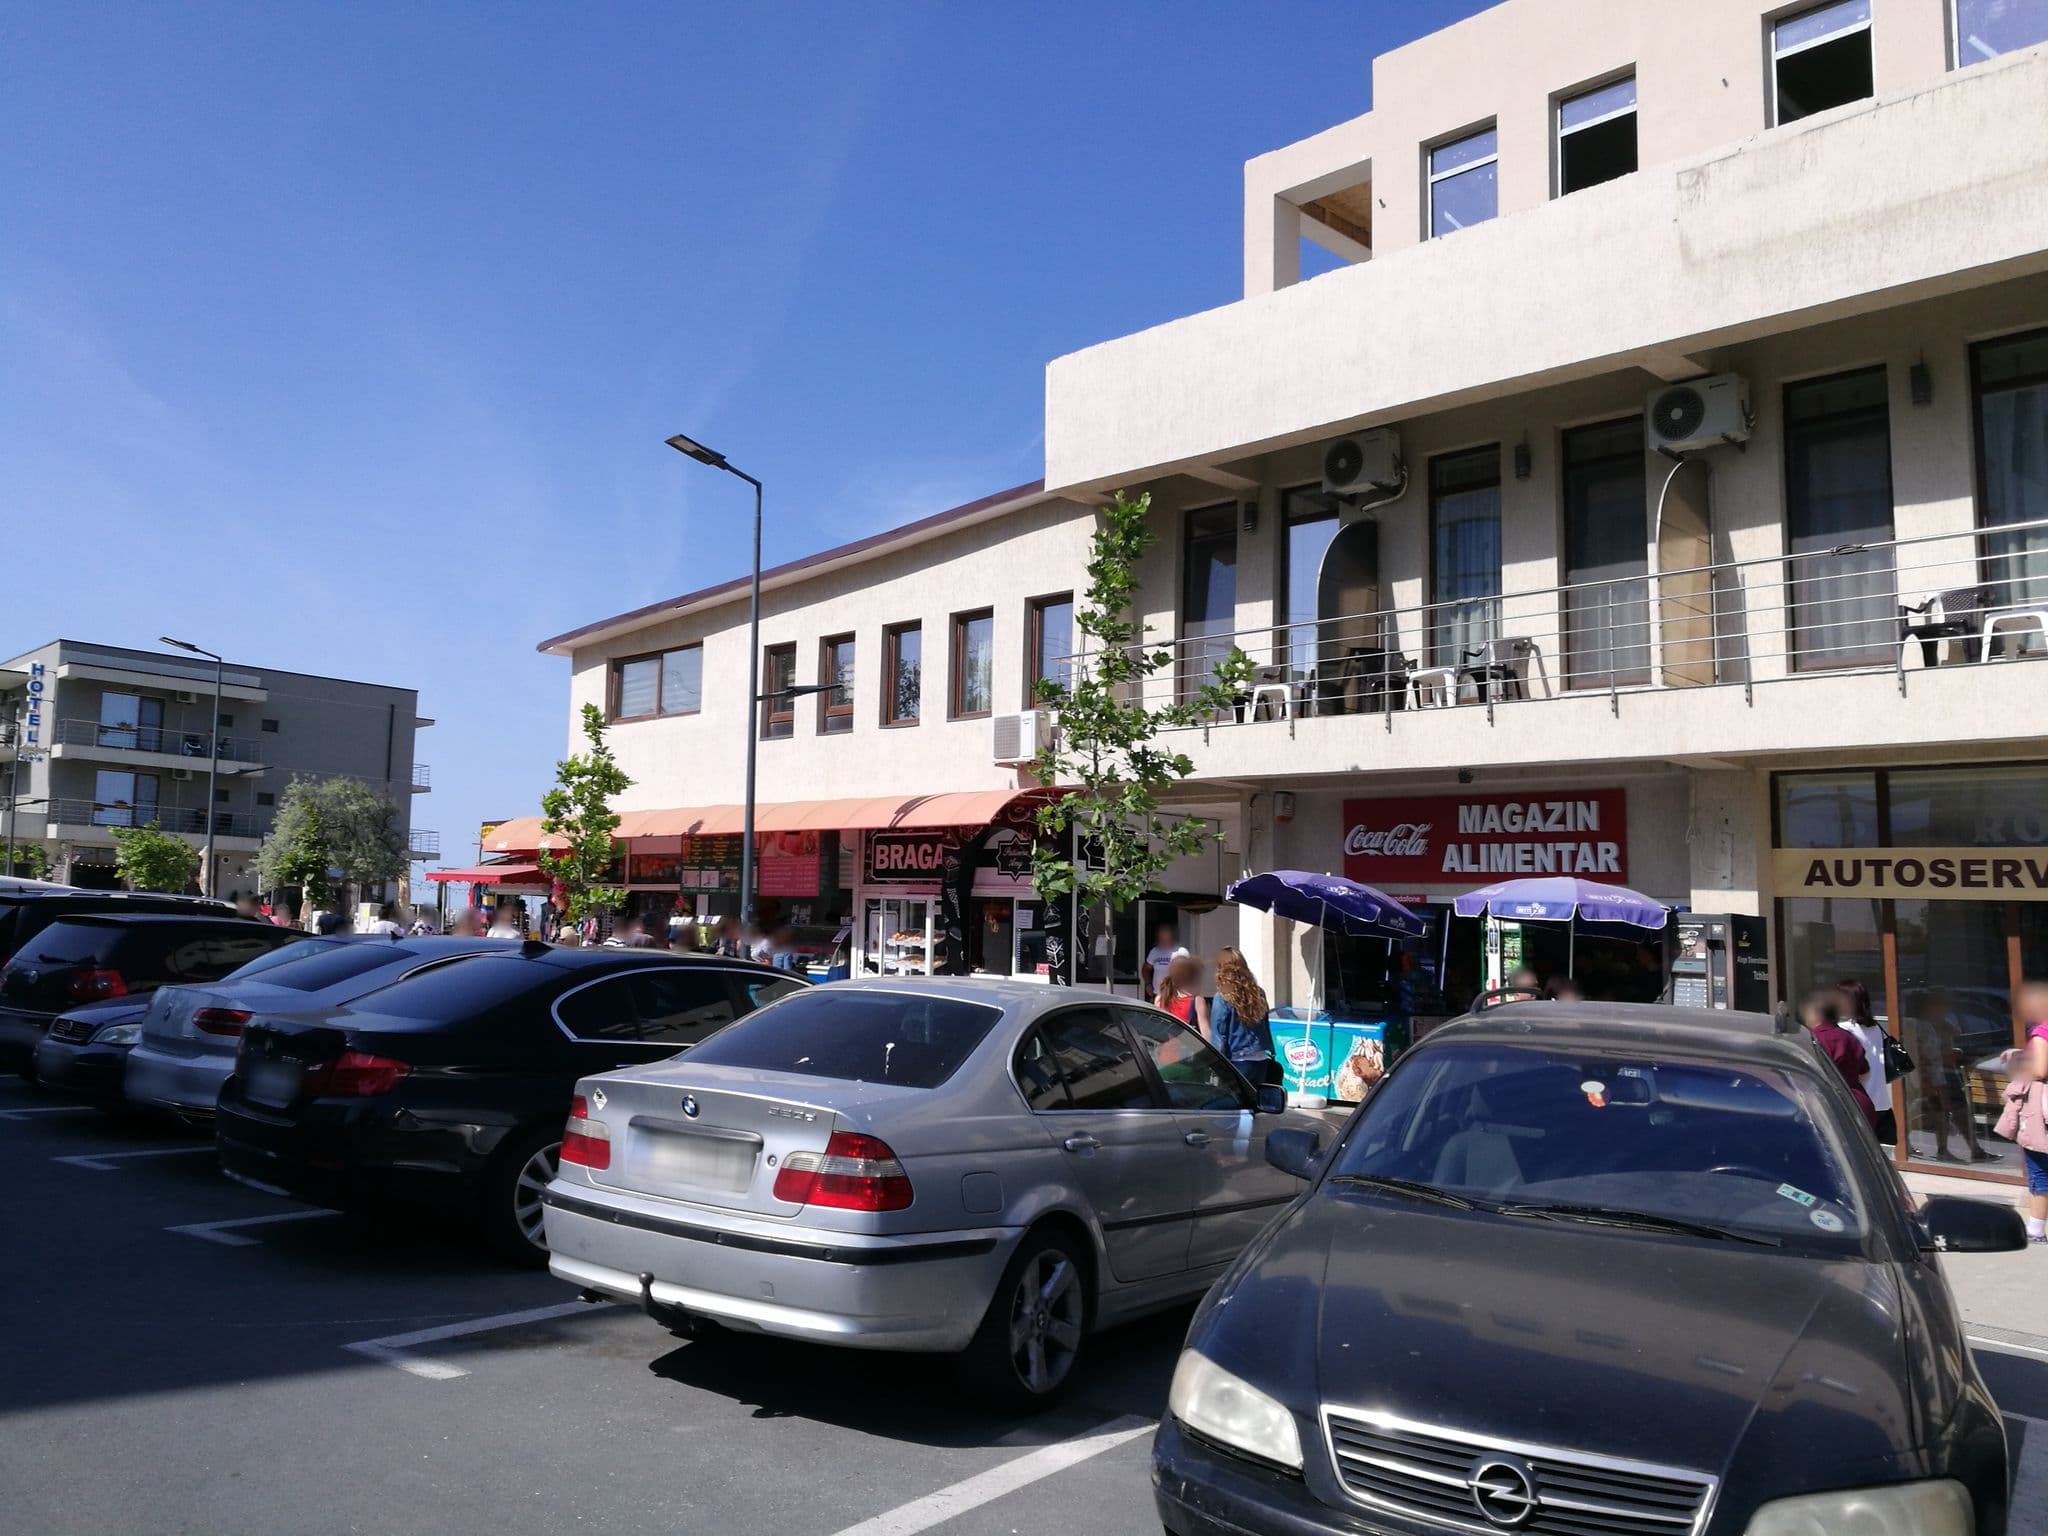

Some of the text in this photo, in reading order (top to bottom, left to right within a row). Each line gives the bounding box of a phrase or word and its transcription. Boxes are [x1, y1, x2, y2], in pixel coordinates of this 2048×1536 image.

[27, 664, 46, 743] HOTEL
[1458, 801, 1601, 834] MAGAZIN
[1344, 823, 1432, 856] Coca-Cola
[874, 843, 943, 870] BRAGA
[1441, 842, 1622, 873] ALIMENTAR
[1804, 858, 2048, 889] AUTOSERV
